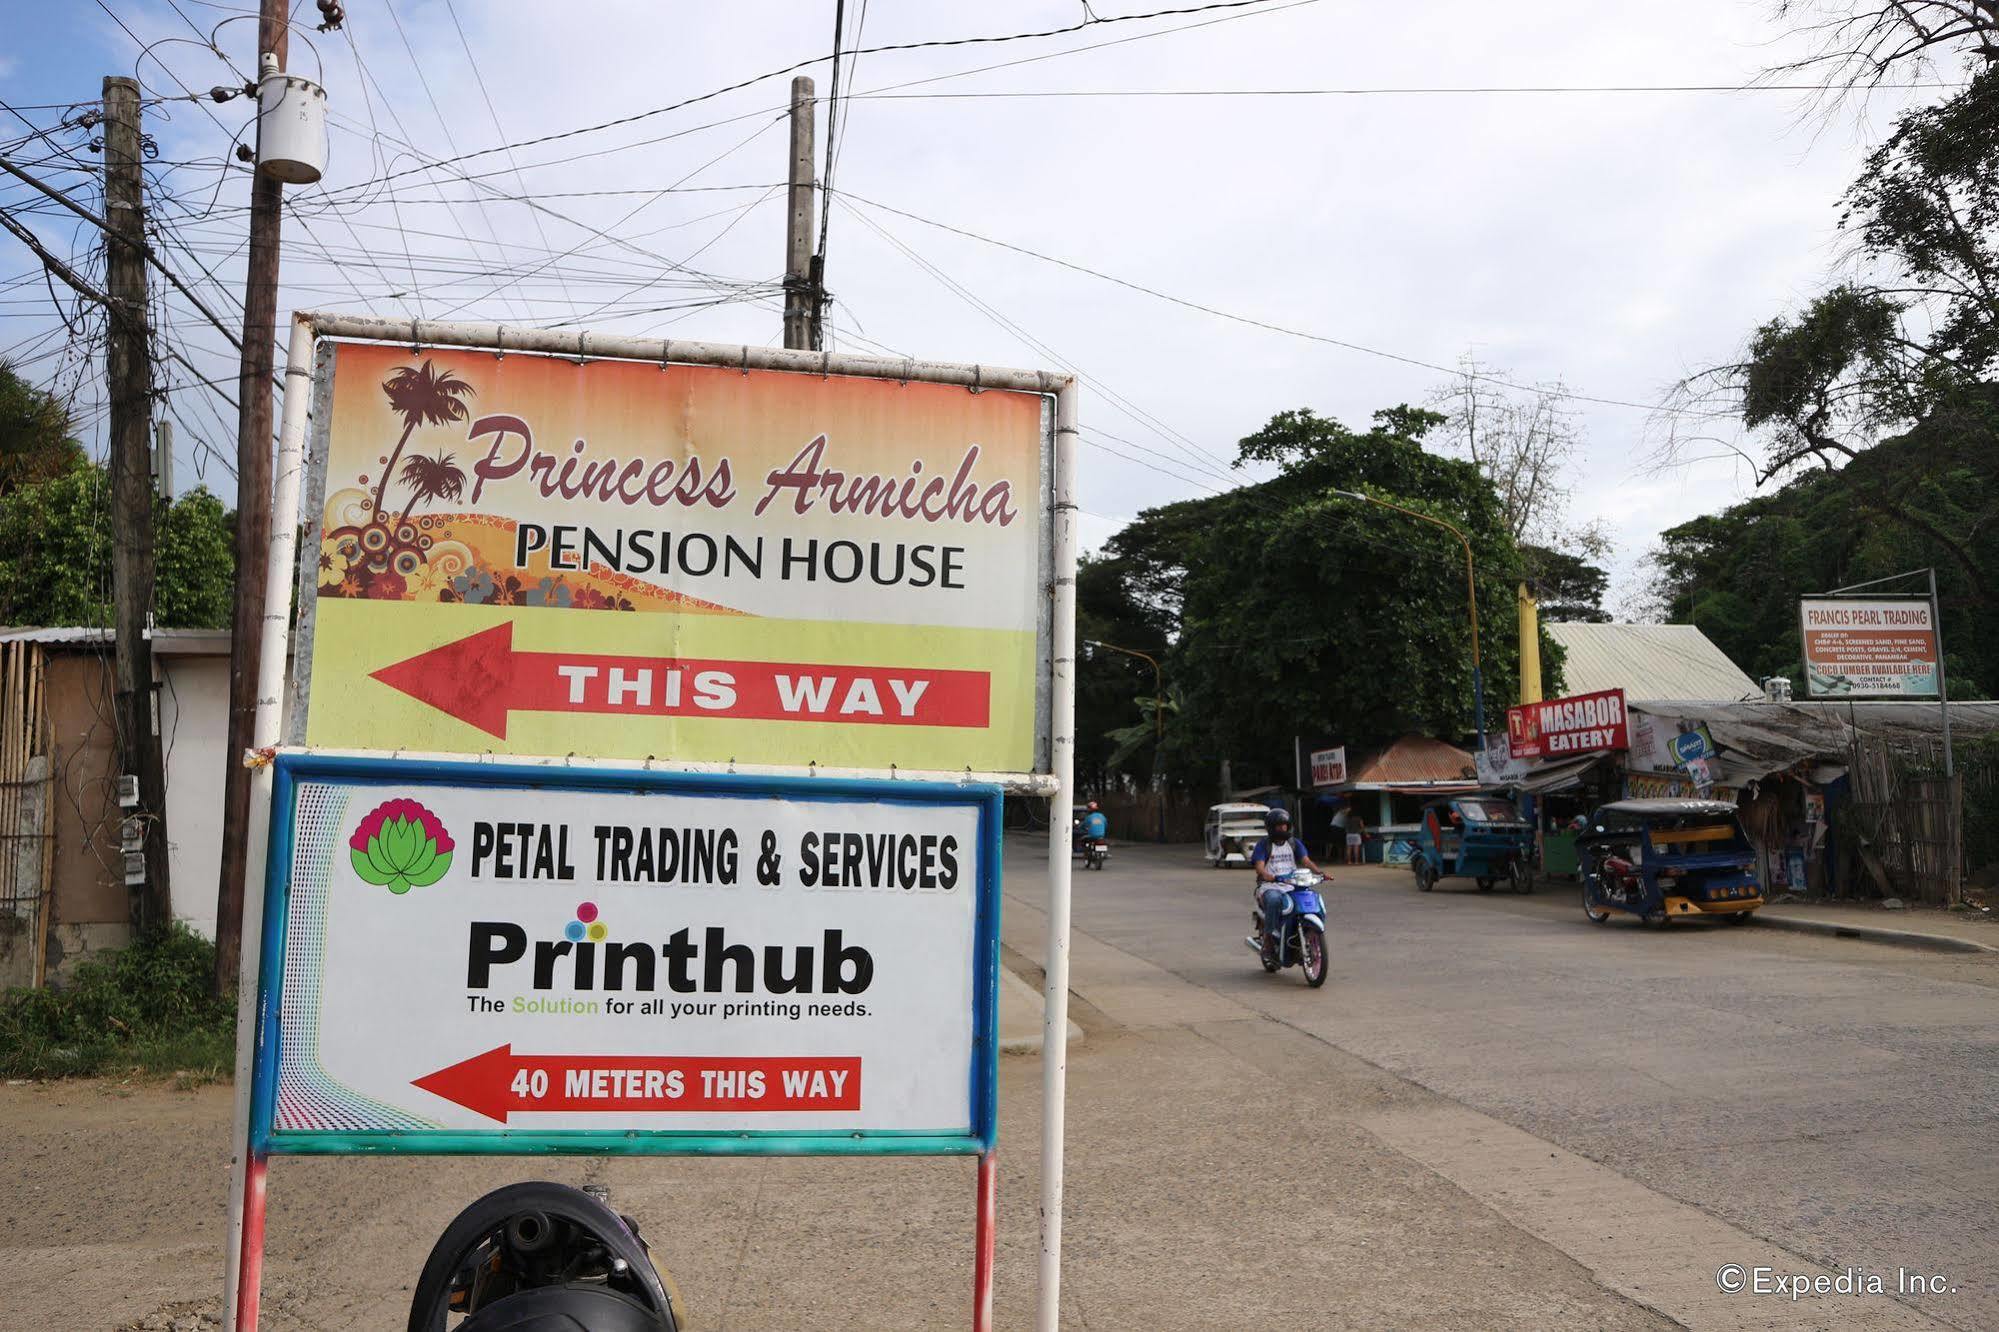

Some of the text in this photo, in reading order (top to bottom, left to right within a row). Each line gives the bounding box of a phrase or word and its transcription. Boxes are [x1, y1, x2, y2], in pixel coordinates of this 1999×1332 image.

[468, 412, 1018, 528] Princess Armicha
[515, 522, 966, 590] PENSION HOUSE
[1808, 610, 1928, 625] FRANCIS PEARL TRADING
[1816, 665, 1932, 675] COCO LUMBER AVAILABLE HERE
[557, 664, 930, 719] THIS WAY
[1540, 695, 1622, 734] MASABOR
[1549, 728, 1615, 751] EATERY
[471, 821, 959, 890] PETAL TRADING & SERVICES
[467, 916, 874, 995] Printhub
[467, 996, 872, 1021] The Solution for all your printing needs.
[511, 1068, 849, 1099] 40 METERS THIS WAY
